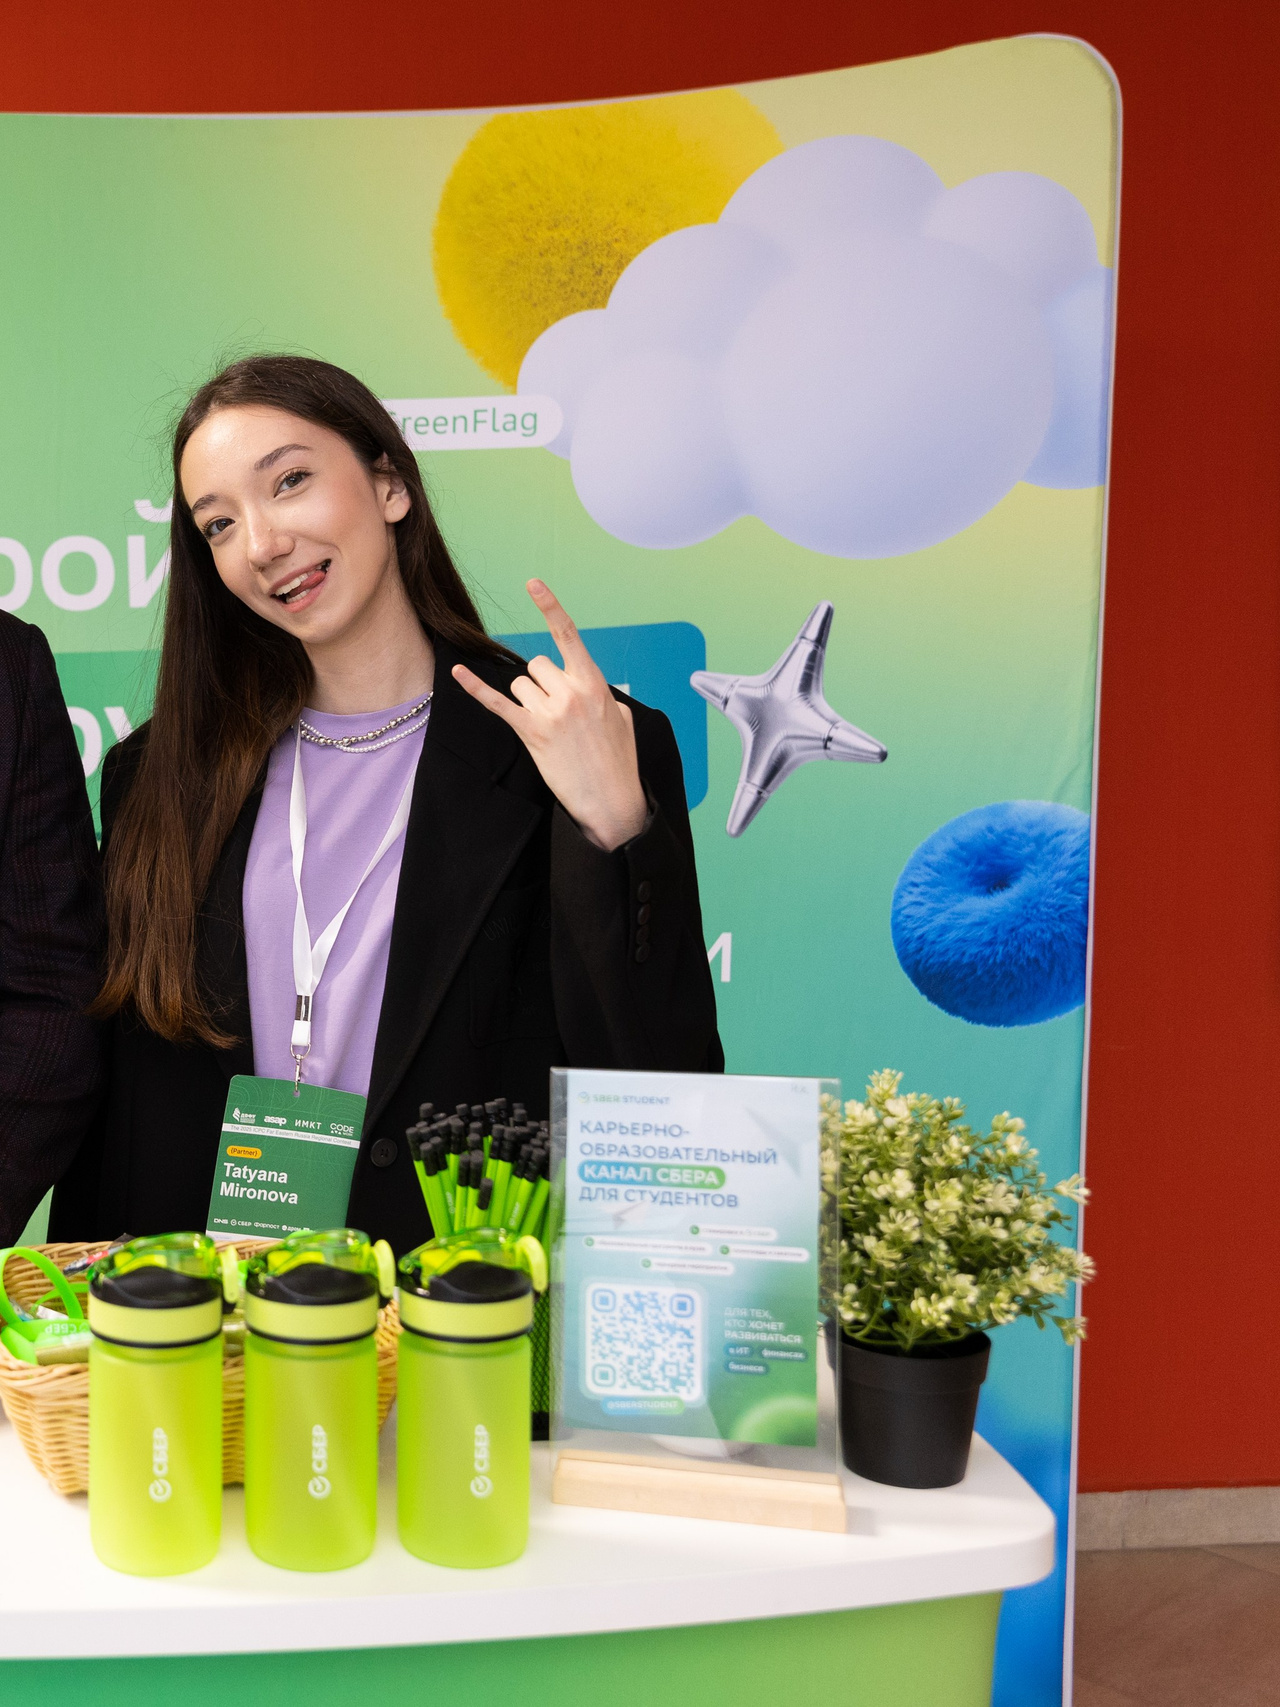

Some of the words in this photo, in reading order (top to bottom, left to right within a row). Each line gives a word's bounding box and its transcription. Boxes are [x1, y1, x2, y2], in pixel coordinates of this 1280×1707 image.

[389, 407, 538, 437] reenFlag
[264, 1115, 287, 1126] asap
[295, 1119, 321, 1130] ИМКТ
[329, 1122, 354, 1133] CODE
[579, 1120, 690, 1138] КАРЬЕРНО-
[579, 1142, 777, 1165] ОБРАЗОВАТЕЛЬНЫЙ
[223, 1162, 288, 1184] Tatyana
[584, 1164, 653, 1182] КАНАЛ
[656, 1167, 719, 1185] СБЕРА
[220, 1181, 298, 1205] Mironova
[579, 1186, 619, 1202] ДЛЯ
[624, 1188, 739, 1208] СТУДЕНТОВ
[724, 1307, 748, 1317] ДЛЯ
[724, 1319, 746, 1327] КТО
[748, 1320, 785, 1331] ХОЧЕТ
[724, 1330, 802, 1344] РАЗВИВАТЬСЯ
[153, 1427, 168, 1477] СБЕР
[311, 1424, 328, 1474] СБЕР
[474, 1424, 490, 1474] СБЕР
